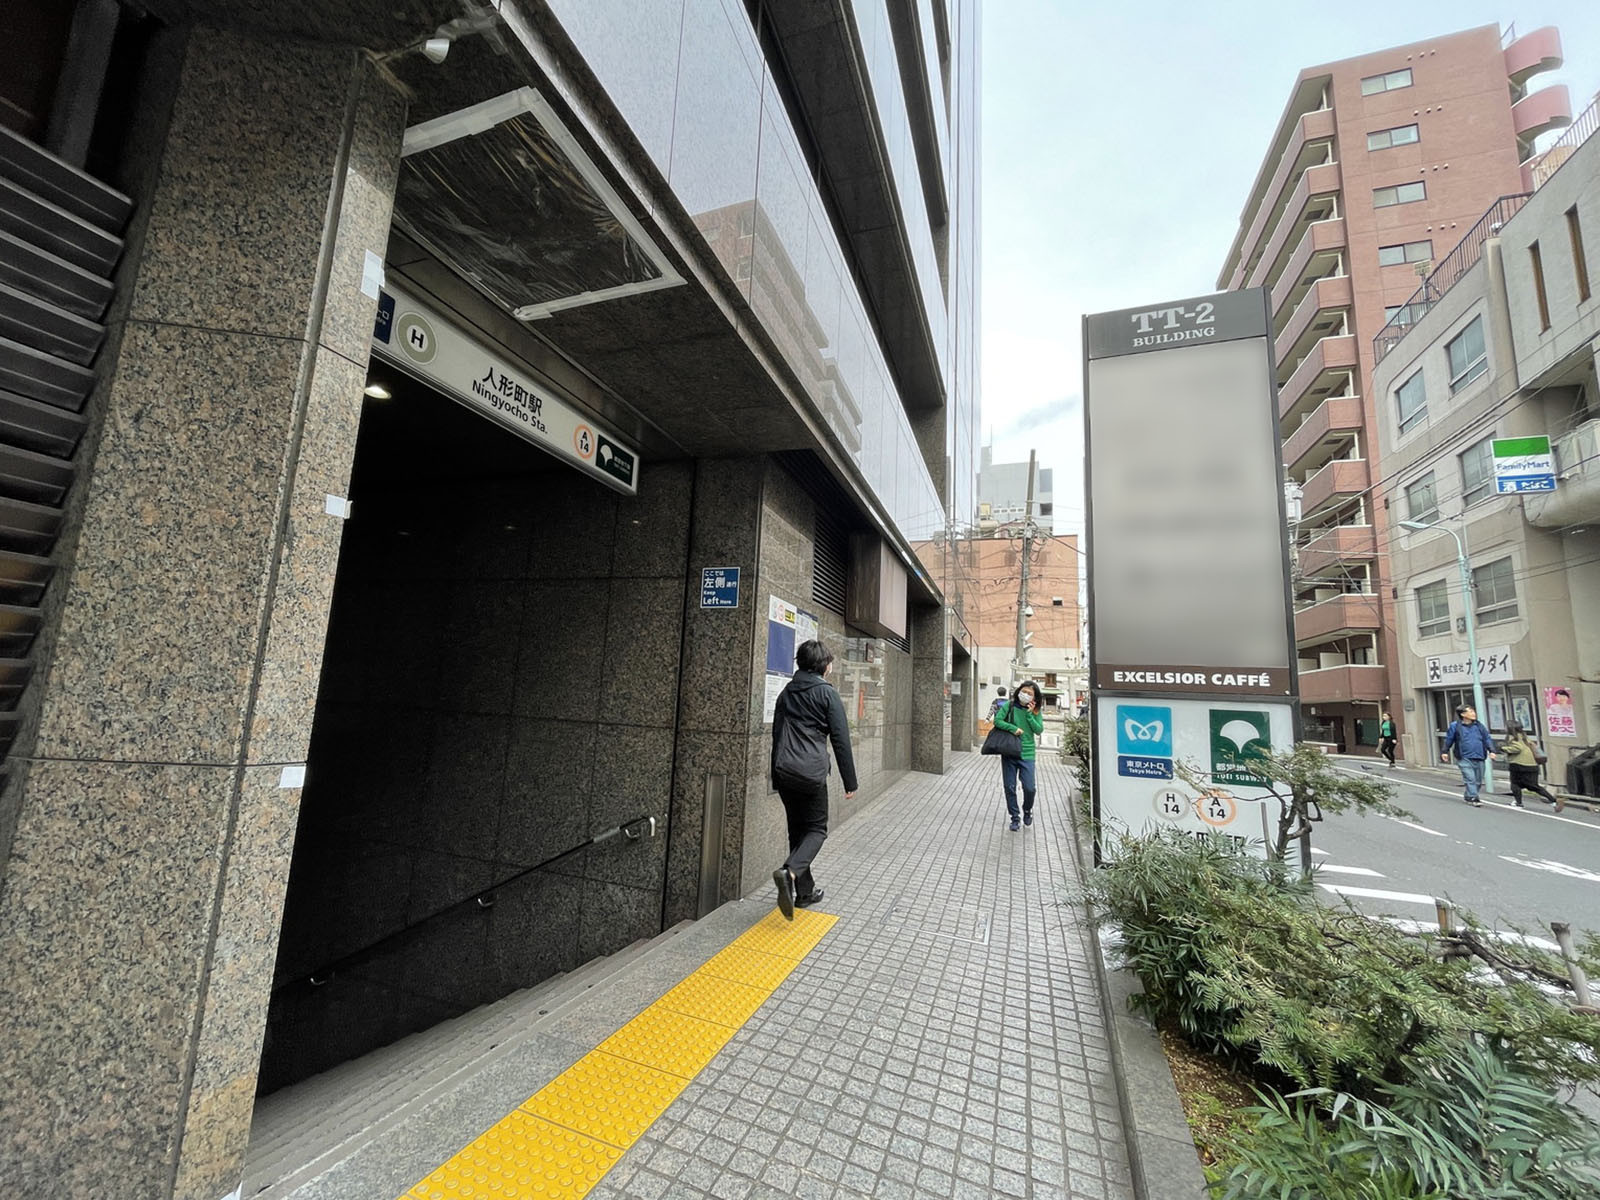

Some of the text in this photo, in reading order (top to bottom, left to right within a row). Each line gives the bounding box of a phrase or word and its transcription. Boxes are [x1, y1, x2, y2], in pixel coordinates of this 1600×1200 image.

[1131, 303, 1215, 333] TT-2
[410, 328, 425, 349] H
[1133, 327, 1215, 346] BUILDING
[482, 366, 543, 417] 人形町駅
[472, 379, 548, 434] Ningyocho Sta.
[582, 431, 588, 442] A
[580, 439, 589, 453] 14
[1496, 461, 1550, 470] FamilyMart
[703, 596, 719, 605] Left
[1114, 671, 1270, 687] EXCELSIOR CAFFÉ
[1126, 760, 1165, 770] 東京メトロ
[1129, 767, 1145, 775] Tokyo
[1166, 793, 1176, 802] H
[1211, 797, 1221, 807] A
[1164, 803, 1180, 814] 14
[1208, 807, 1226, 818] 14
